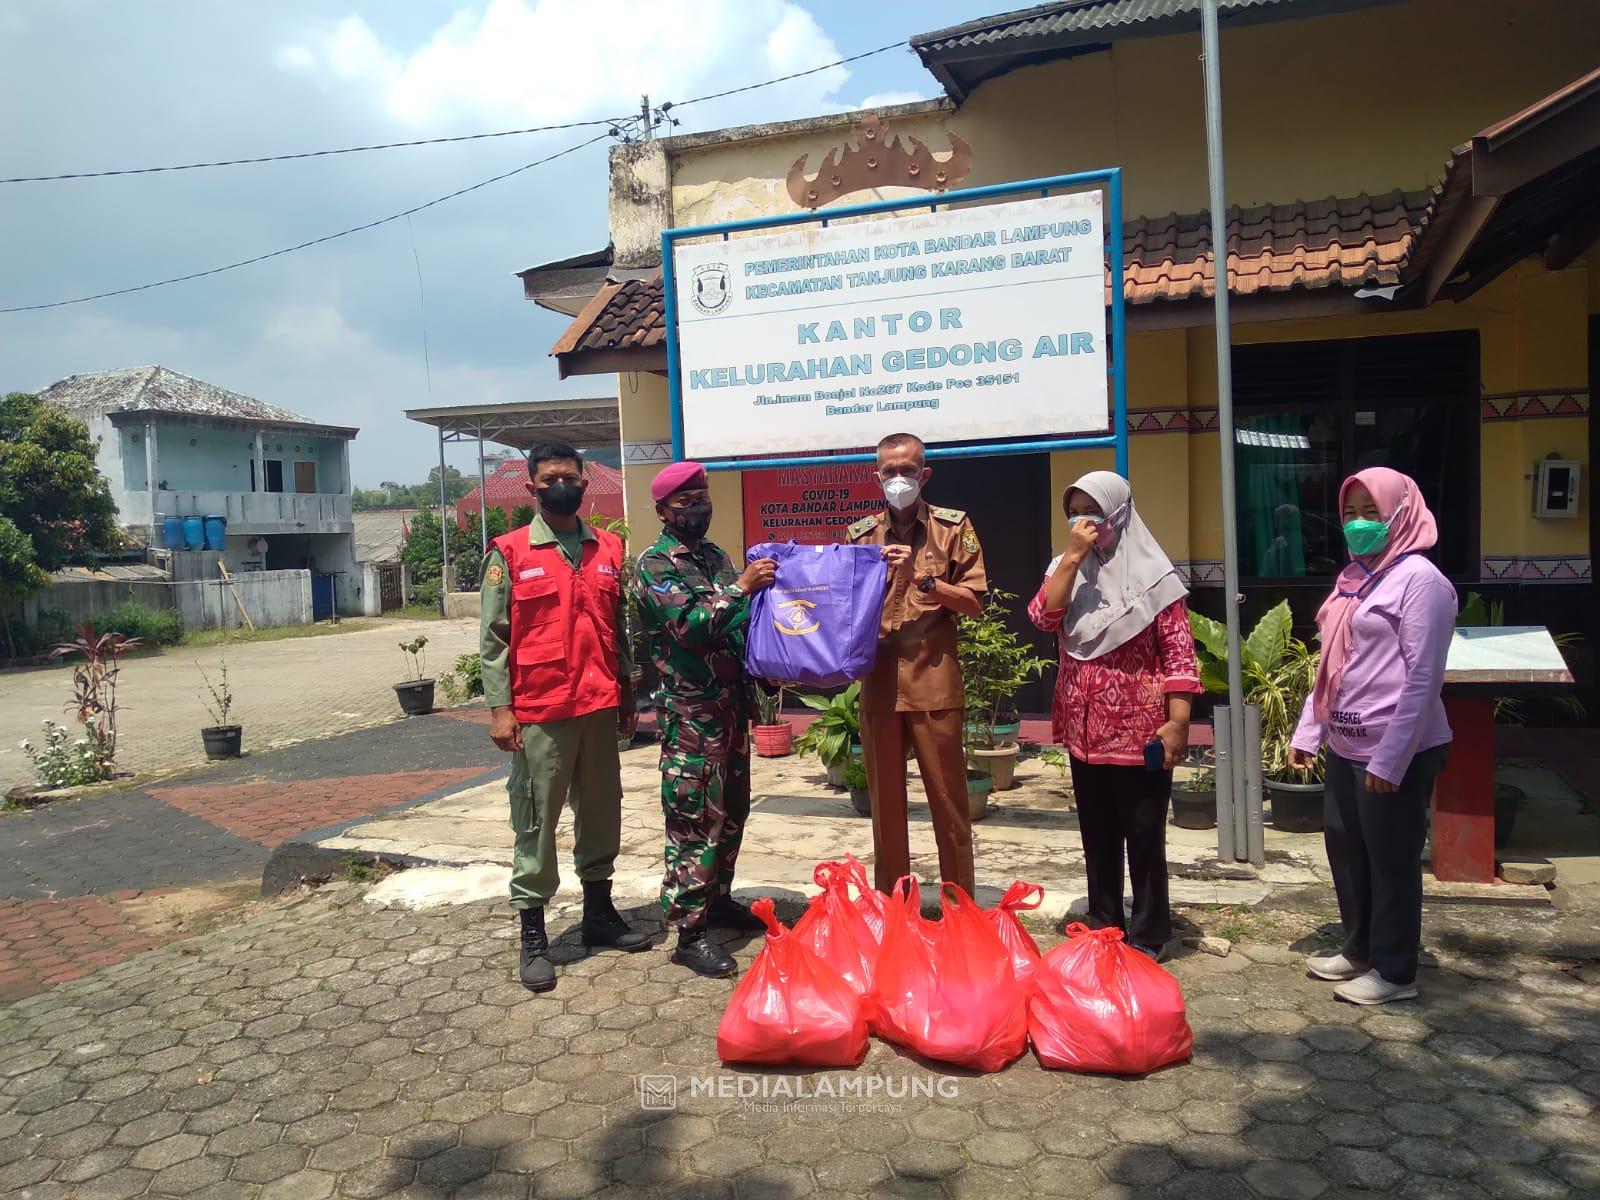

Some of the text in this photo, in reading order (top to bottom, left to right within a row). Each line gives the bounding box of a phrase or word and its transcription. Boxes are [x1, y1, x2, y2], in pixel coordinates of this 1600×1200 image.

[744, 219, 1092, 276] PEMERINTAHAN KOTA BANDAR LAMPUNG
[745, 247, 1072, 300] KECAMATAN TANJUNG KARANG BARAT
[797, 307, 963, 344] KANTOR
[690, 332, 1095, 389] KELURAHAN GEDONG AIR
[814, 387, 856, 401] Bonjol
[906, 380, 943, 393] Kode
[946, 377, 973, 390] Pos
[975, 373, 1020, 387] 35151
[825, 398, 940, 416] Bandar Lampung
[760, 499, 888, 514] KOTA BANDAR LAMPUN
[802, 489, 850, 501] COVID-19
[763, 517, 822, 527] KELURAHAN
